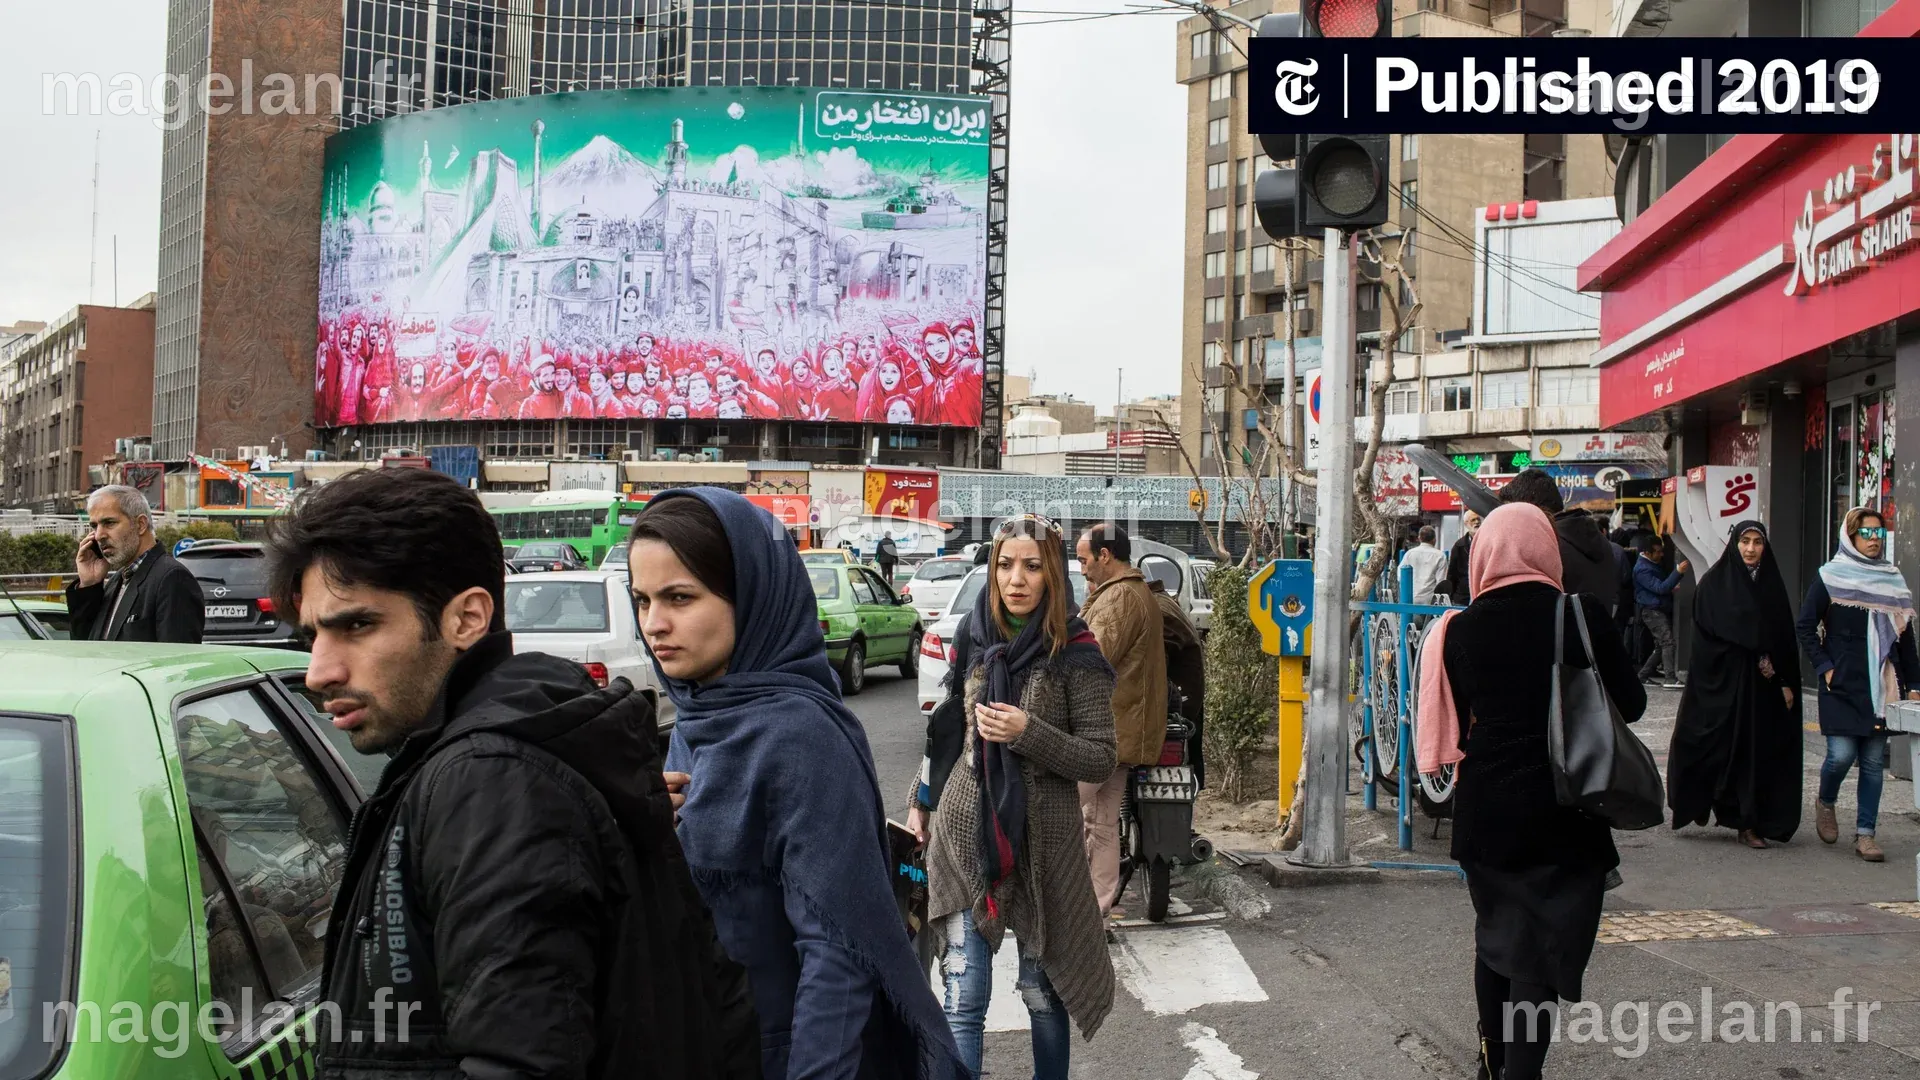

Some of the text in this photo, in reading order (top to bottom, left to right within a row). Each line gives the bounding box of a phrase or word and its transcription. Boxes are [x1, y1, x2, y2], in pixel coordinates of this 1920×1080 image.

[821, 98, 986, 138] ایران افتخار من
[832, 130, 863, 142] وطن
[863, 131, 883, 142] برای
[901, 134, 926, 143] دست
[926, 135, 937, 145] در
[937, 136, 969, 145] دست
[1783, 165, 1856, 296] شهر
[1818, 205, 1912, 284] BANK SHAHR
[419, 318, 436, 334] شاه
[892, 476, 933, 489] فست فود
[1421, 482, 1450, 493] Pharm
[1560, 474, 1589, 488] SHOE
[890, 491, 918, 514] آرام
